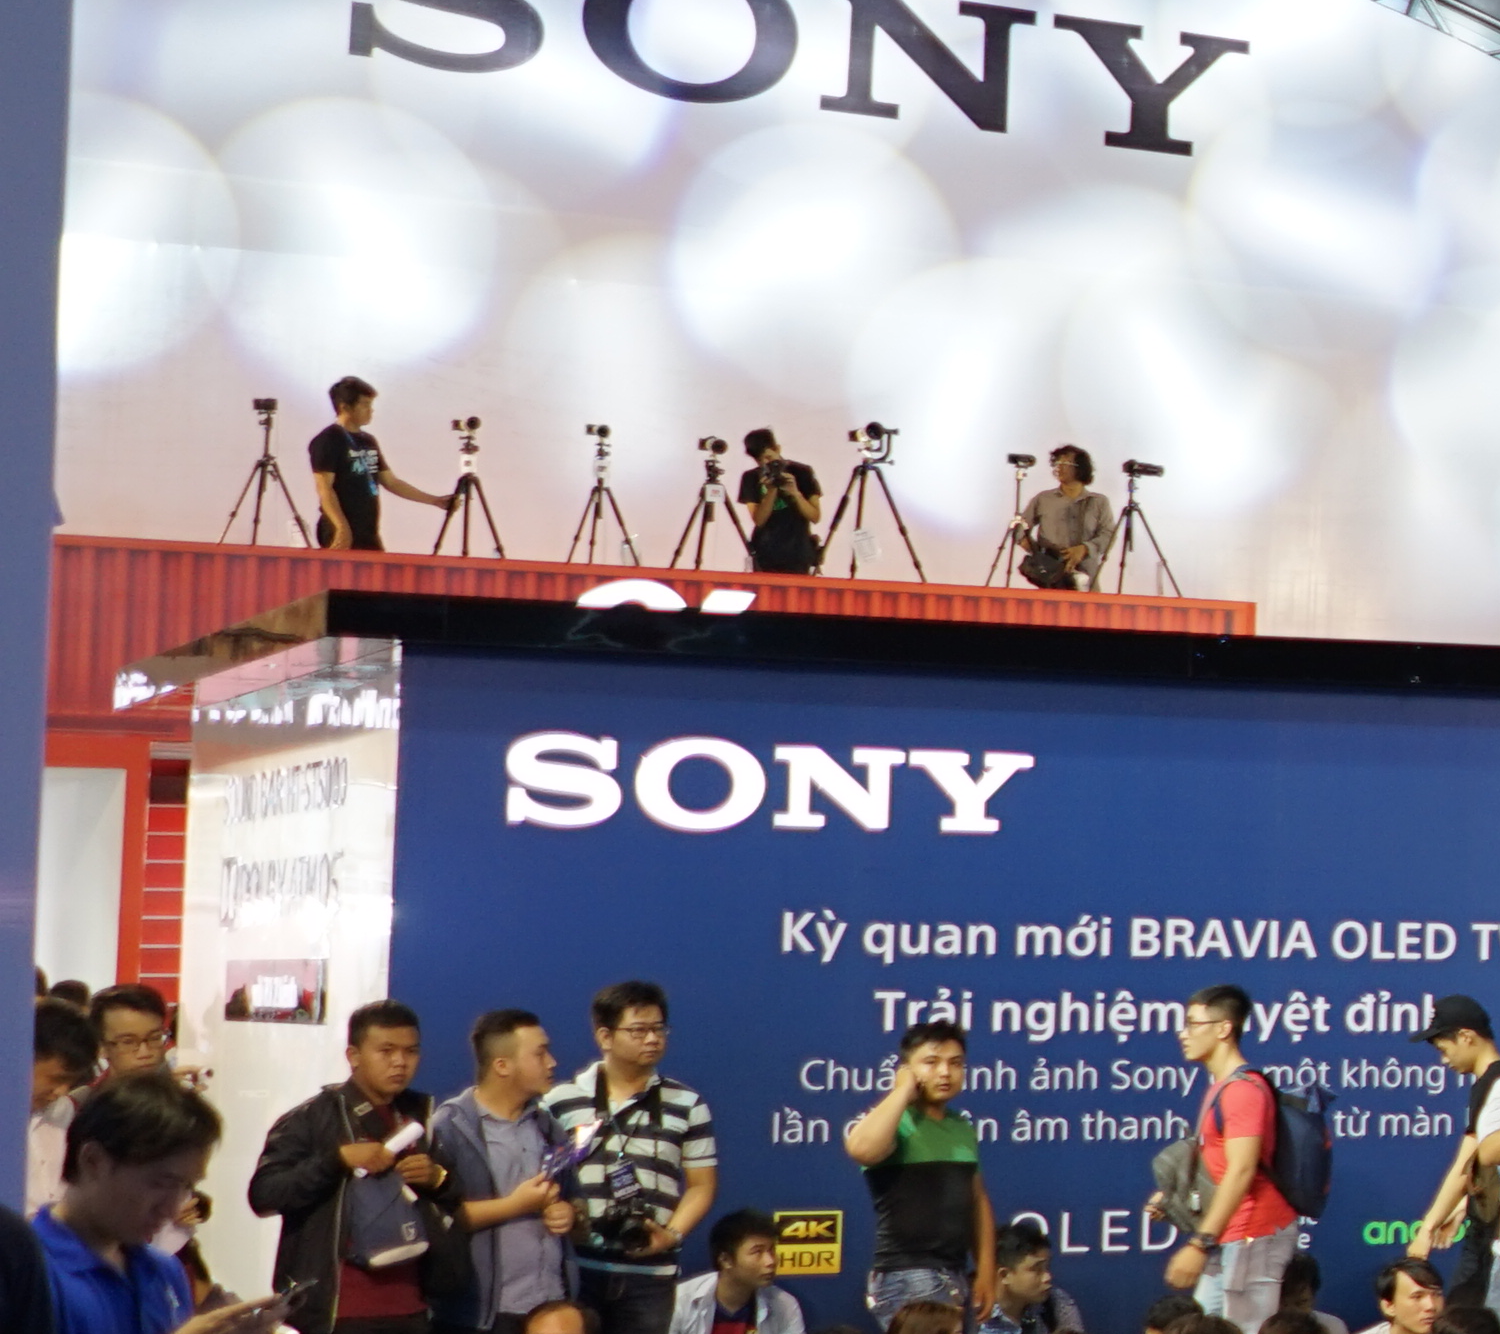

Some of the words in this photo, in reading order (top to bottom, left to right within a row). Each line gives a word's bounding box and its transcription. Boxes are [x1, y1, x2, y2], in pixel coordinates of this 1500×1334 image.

[505, 729, 1036, 835] SONY
[780, 908, 848, 964] Kỳ
[862, 920, 998, 965] quan
[1015, 913, 1113, 958] mới
[1129, 916, 1318, 960] BRAVIA
[1331, 919, 1458, 961] OLED
[873, 985, 974, 1033] Trải
[991, 989, 1186, 1044] nghiệm
[800, 1053, 899, 1093] Chuẩ
[1029, 1057, 1099, 1093] ảnh
[1109, 1058, 1199, 1098] Sony
[1262, 1055, 1331, 1091] một
[1340, 1056, 1447, 1099] không
[771, 1105, 830, 1145] lần
[1010, 1109, 1069, 1144] âm
[1081, 1109, 1188, 1142] thanh
[1333, 1105, 1369, 1138] từ
[1378, 1107, 1453, 1138] màn
[781, 1219, 836, 1241] 4K
[777, 1250, 836, 1269] HDR
